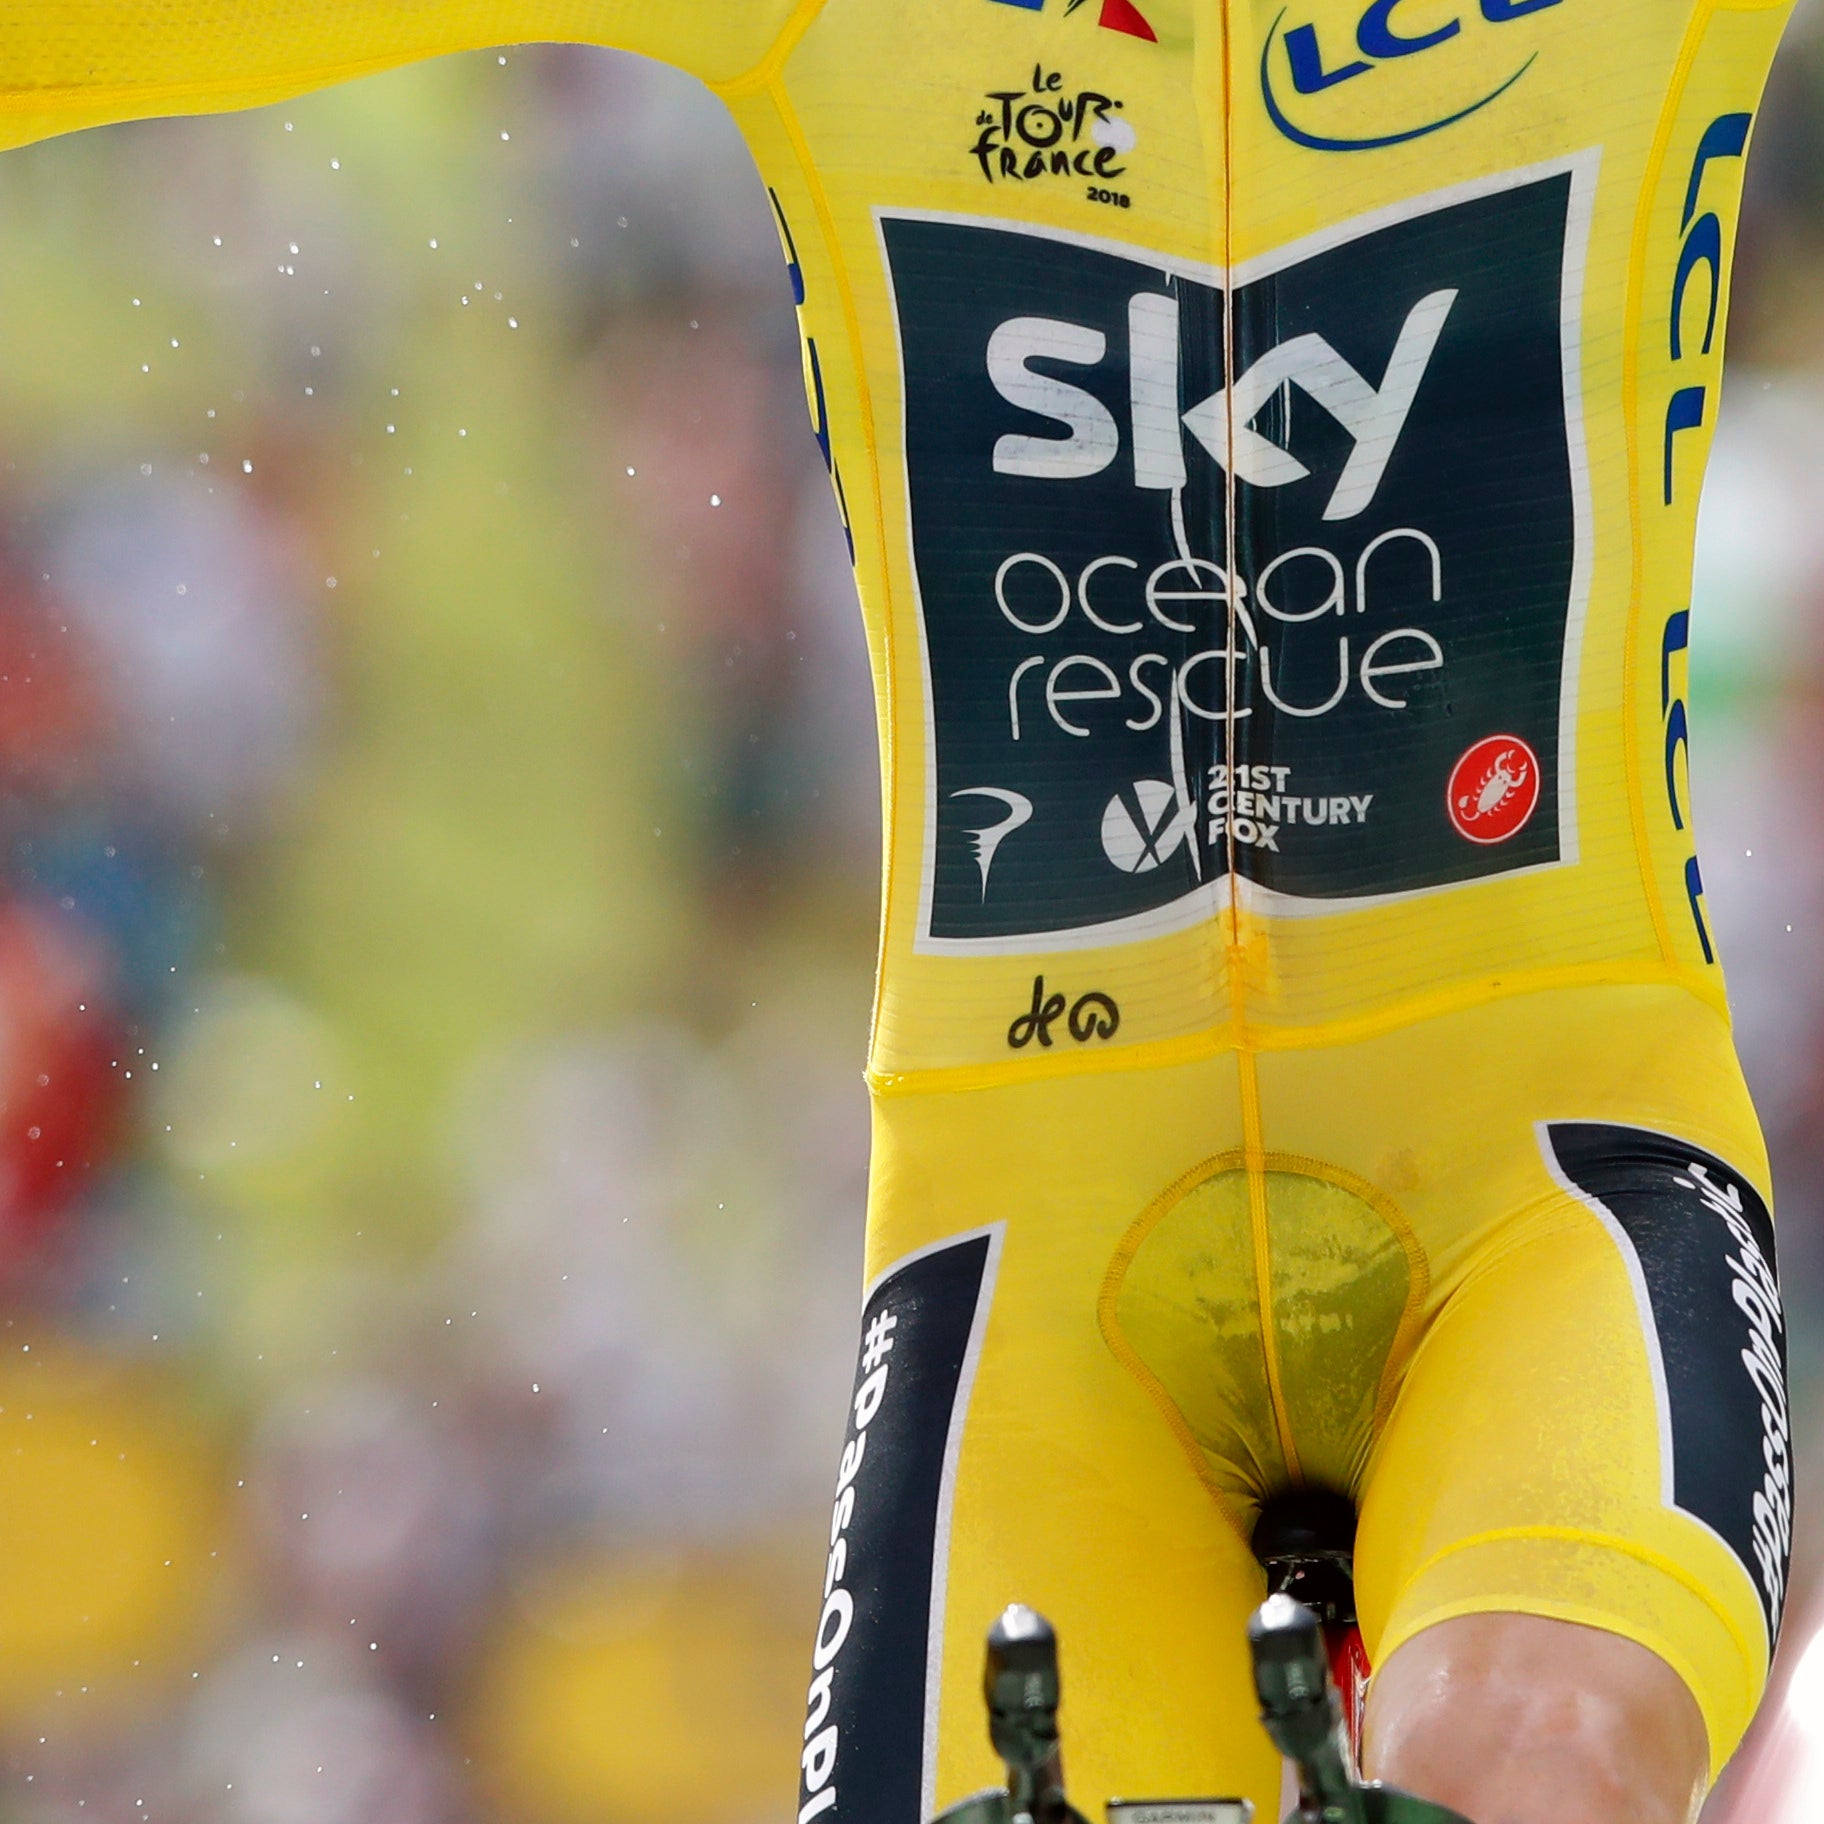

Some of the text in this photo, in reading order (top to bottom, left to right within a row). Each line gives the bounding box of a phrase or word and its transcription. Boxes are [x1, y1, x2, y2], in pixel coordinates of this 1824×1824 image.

[976, 110, 993, 125] de
[1087, 186, 1130, 208] 2018
[1663, 112, 1752, 506] LCL
[985, 289, 1459, 522] sky
[994, 528, 1443, 635] ocean
[1010, 627, 1444, 741] rescue
[1207, 764, 1292, 792] 21ST
[1207, 791, 1374, 827] CENTURY
[1207, 818, 1281, 853] FOX
